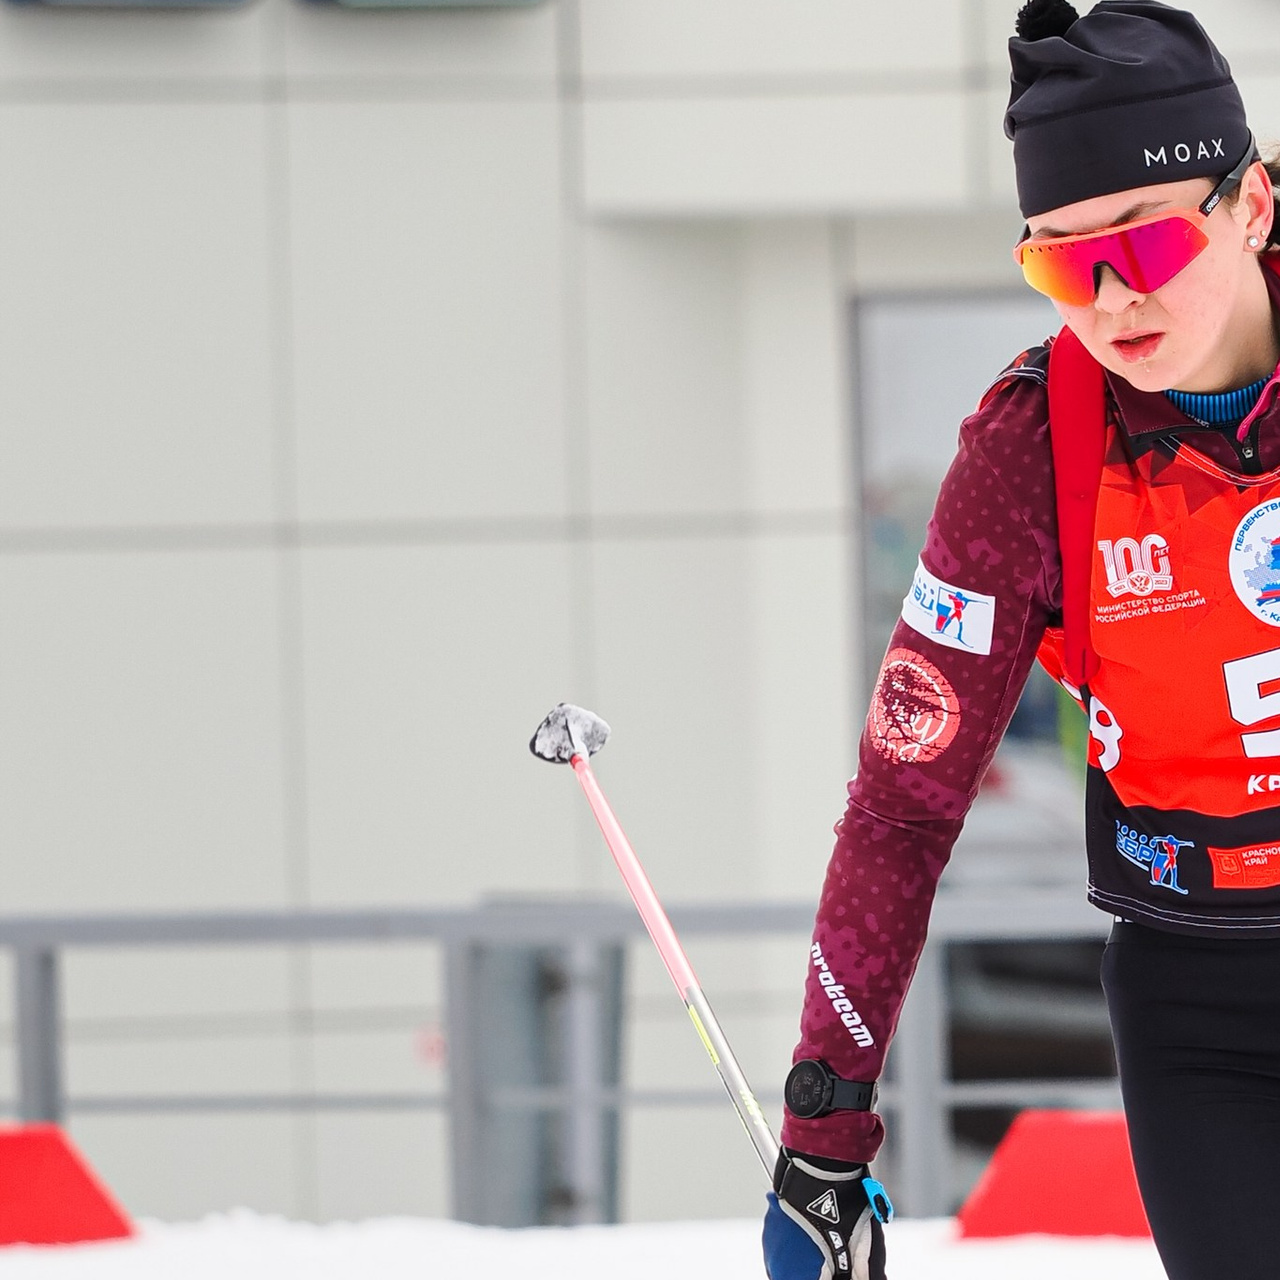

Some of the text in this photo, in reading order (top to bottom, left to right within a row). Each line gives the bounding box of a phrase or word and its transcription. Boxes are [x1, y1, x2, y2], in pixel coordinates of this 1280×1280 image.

[1143, 137, 1225, 168] MOAX
[1153, 546, 1170, 557] ЛЕТ
[1095, 597, 1207, 623] РОССИЙСКОЙ ФЕДЕРАЦИИ
[1096, 589, 1201, 614] МИНИСТЕРСТВО СПОРТА
[1244, 855, 1268, 867] КРАЙ
